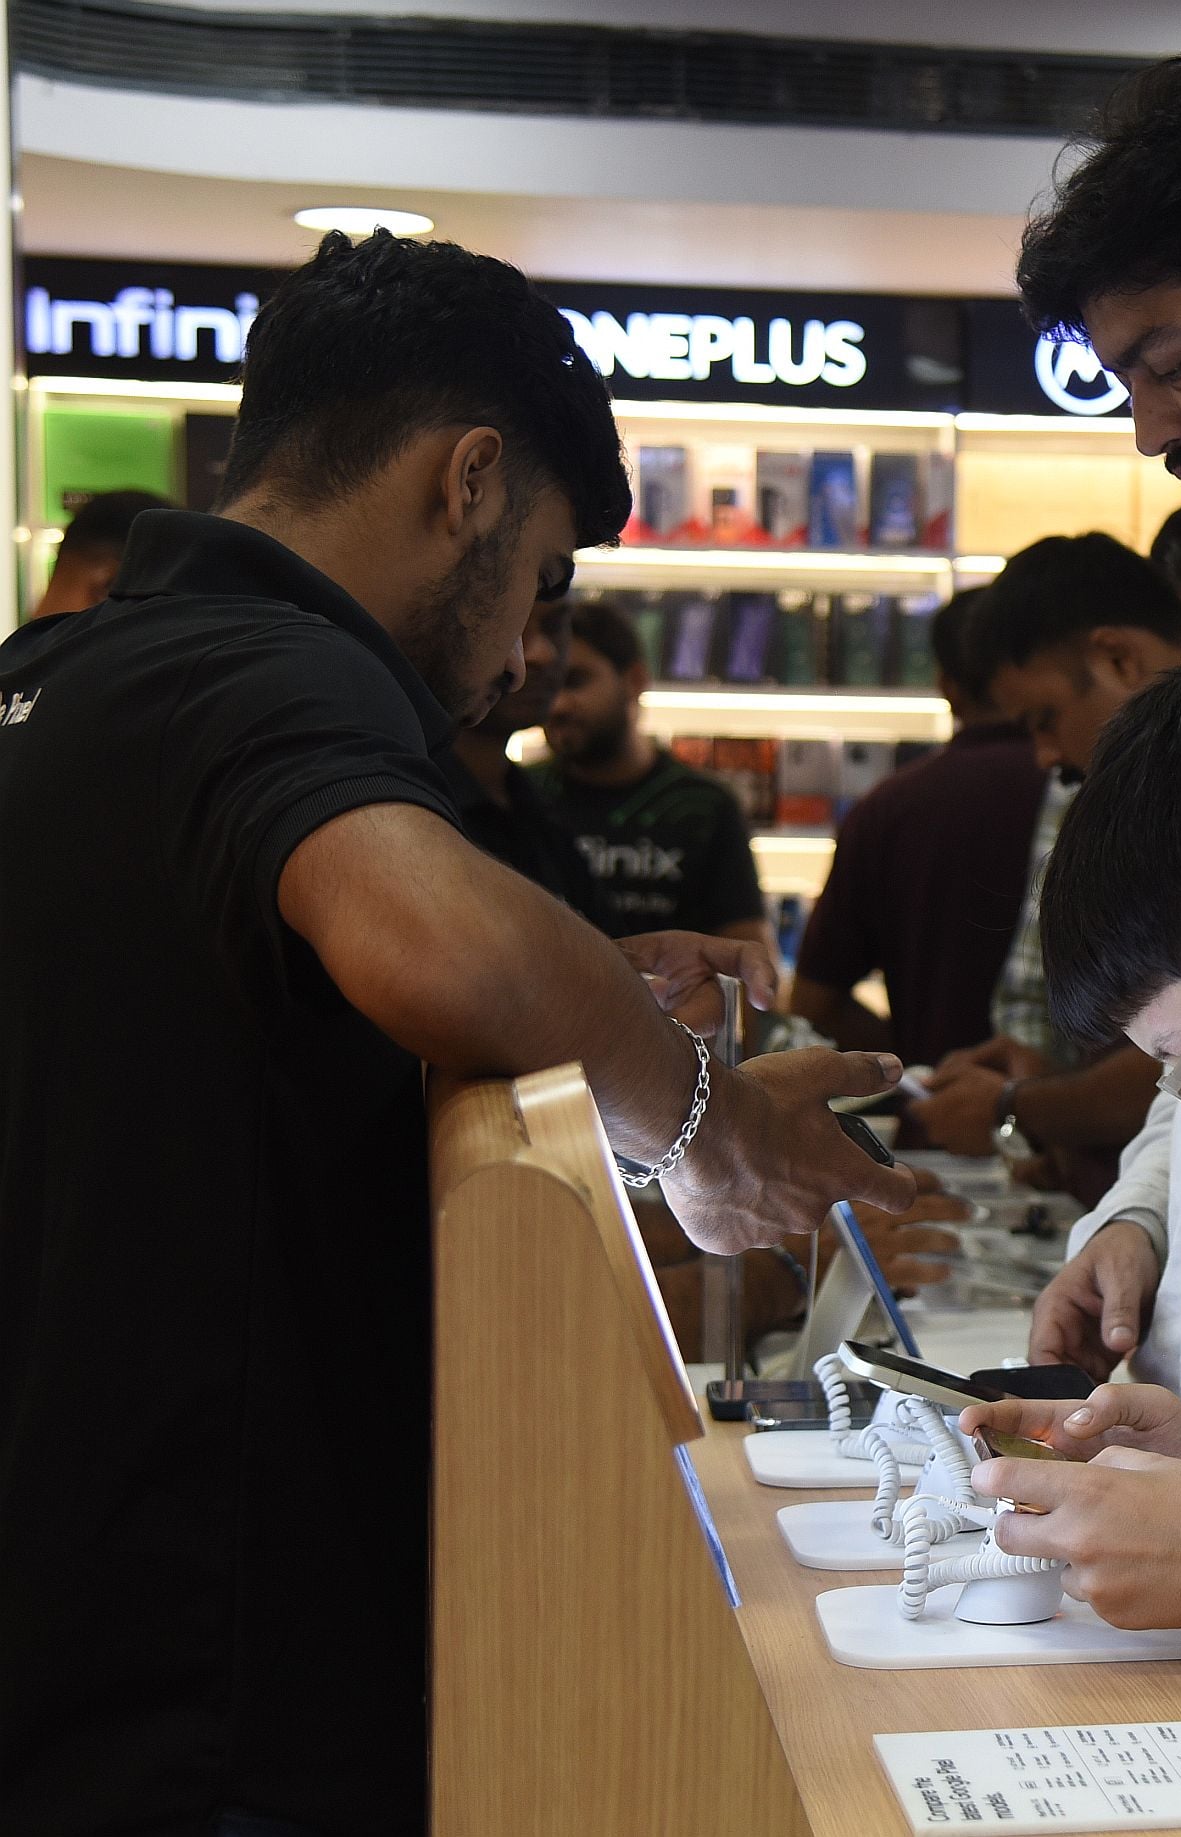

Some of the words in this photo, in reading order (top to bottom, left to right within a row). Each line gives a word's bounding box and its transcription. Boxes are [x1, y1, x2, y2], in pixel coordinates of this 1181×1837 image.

[25, 284, 260, 363] Infini
[556, 307, 867, 387] NEPLUS
[930, 1758, 959, 1775] Pixel
[911, 1776, 934, 1789] the
[940, 1774, 972, 1800] Google
[920, 1789, 951, 1822] Compare
[955, 1800, 983, 1821] latest
